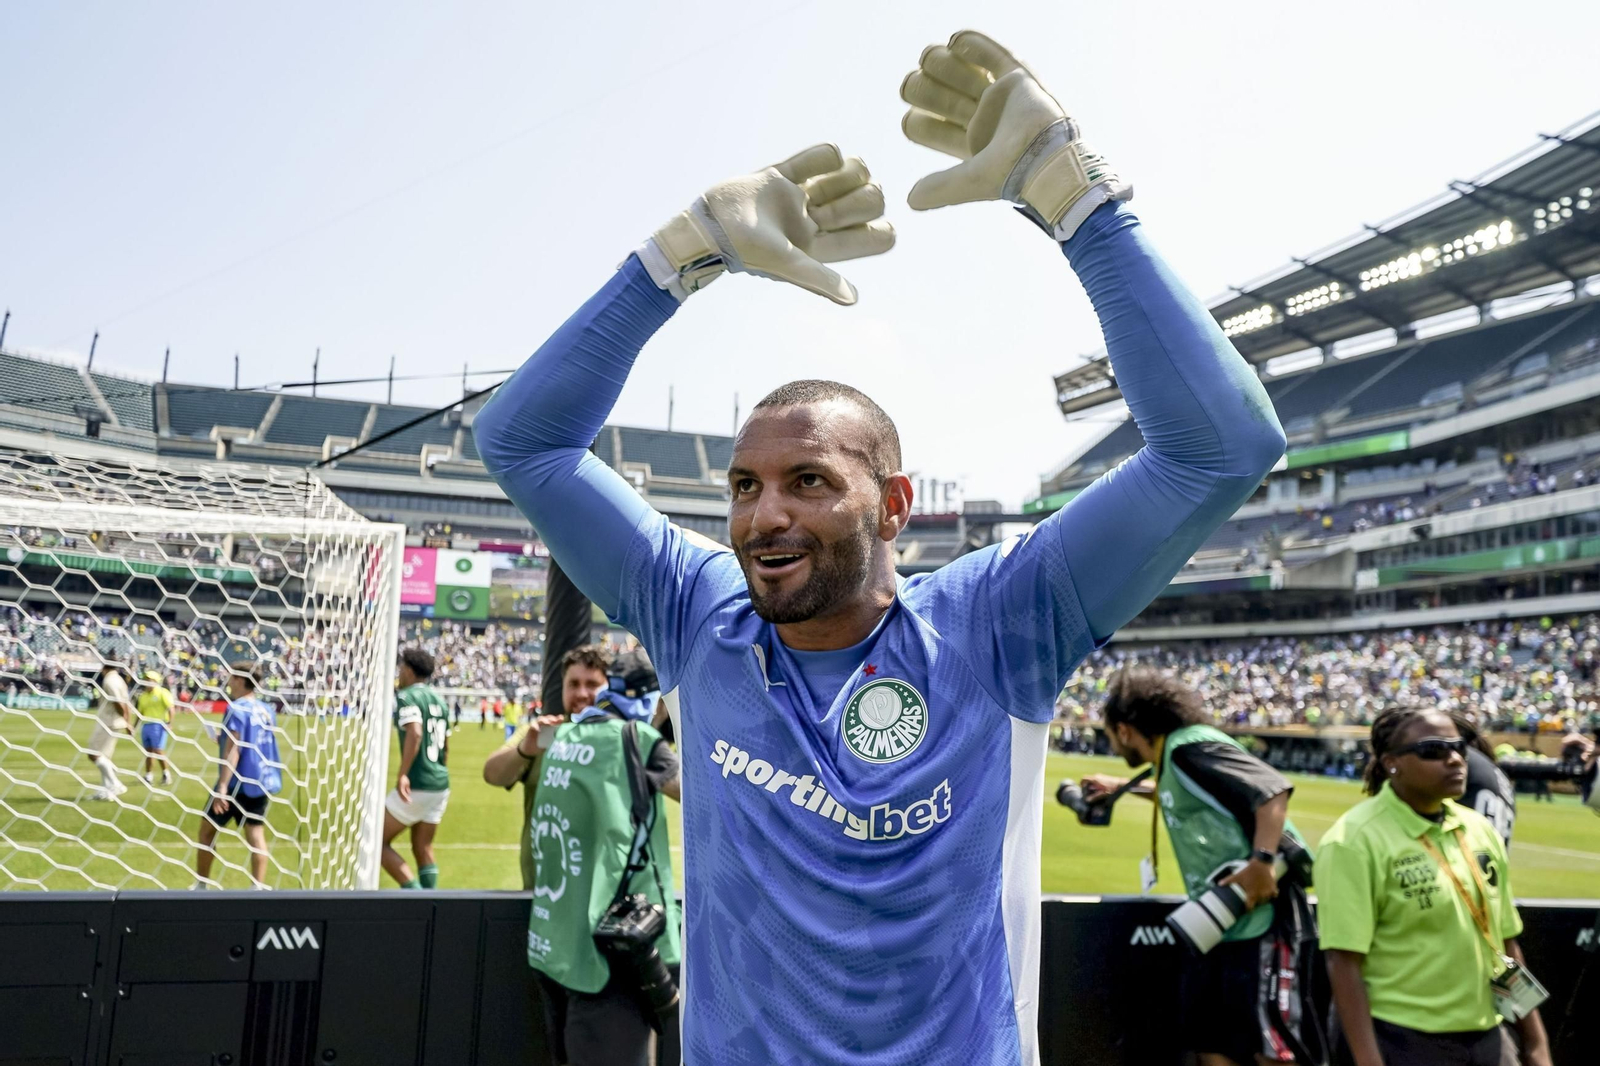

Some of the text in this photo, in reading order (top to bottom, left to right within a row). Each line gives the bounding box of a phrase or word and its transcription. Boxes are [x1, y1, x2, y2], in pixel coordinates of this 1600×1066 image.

[7, 694, 88, 710] Hisense
[847, 705, 923, 758] PALMEIRAS
[546, 740, 596, 766] PHOTO
[543, 765, 572, 790] 504
[709, 739, 951, 841] sportingbet
[568, 836, 583, 877] CUP
